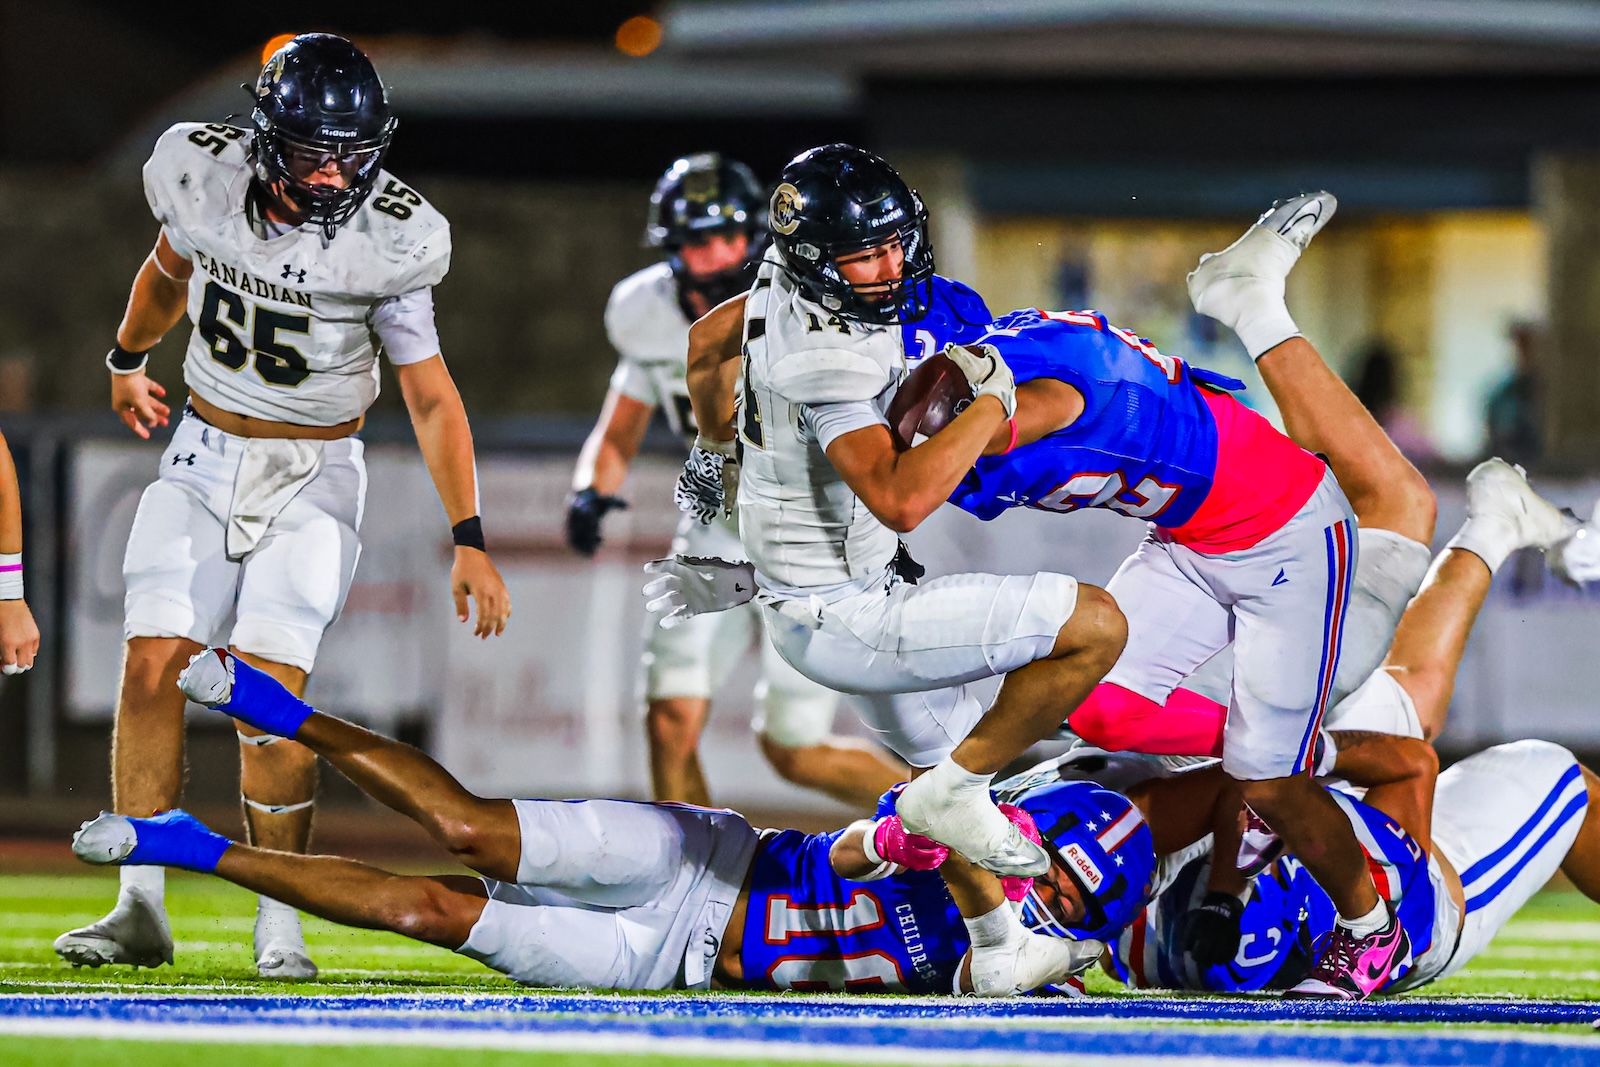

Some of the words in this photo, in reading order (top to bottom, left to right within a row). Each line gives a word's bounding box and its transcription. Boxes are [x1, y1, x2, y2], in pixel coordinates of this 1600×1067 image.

[371, 180, 422, 221] 65
[871, 207, 904, 228] Riddell
[195, 249, 313, 309] CANADIAN
[198, 279, 314, 389] 65
[806, 312, 852, 336] 14
[1067, 846, 1100, 885] Riddell
[895, 903, 938, 981] CHILDRES
